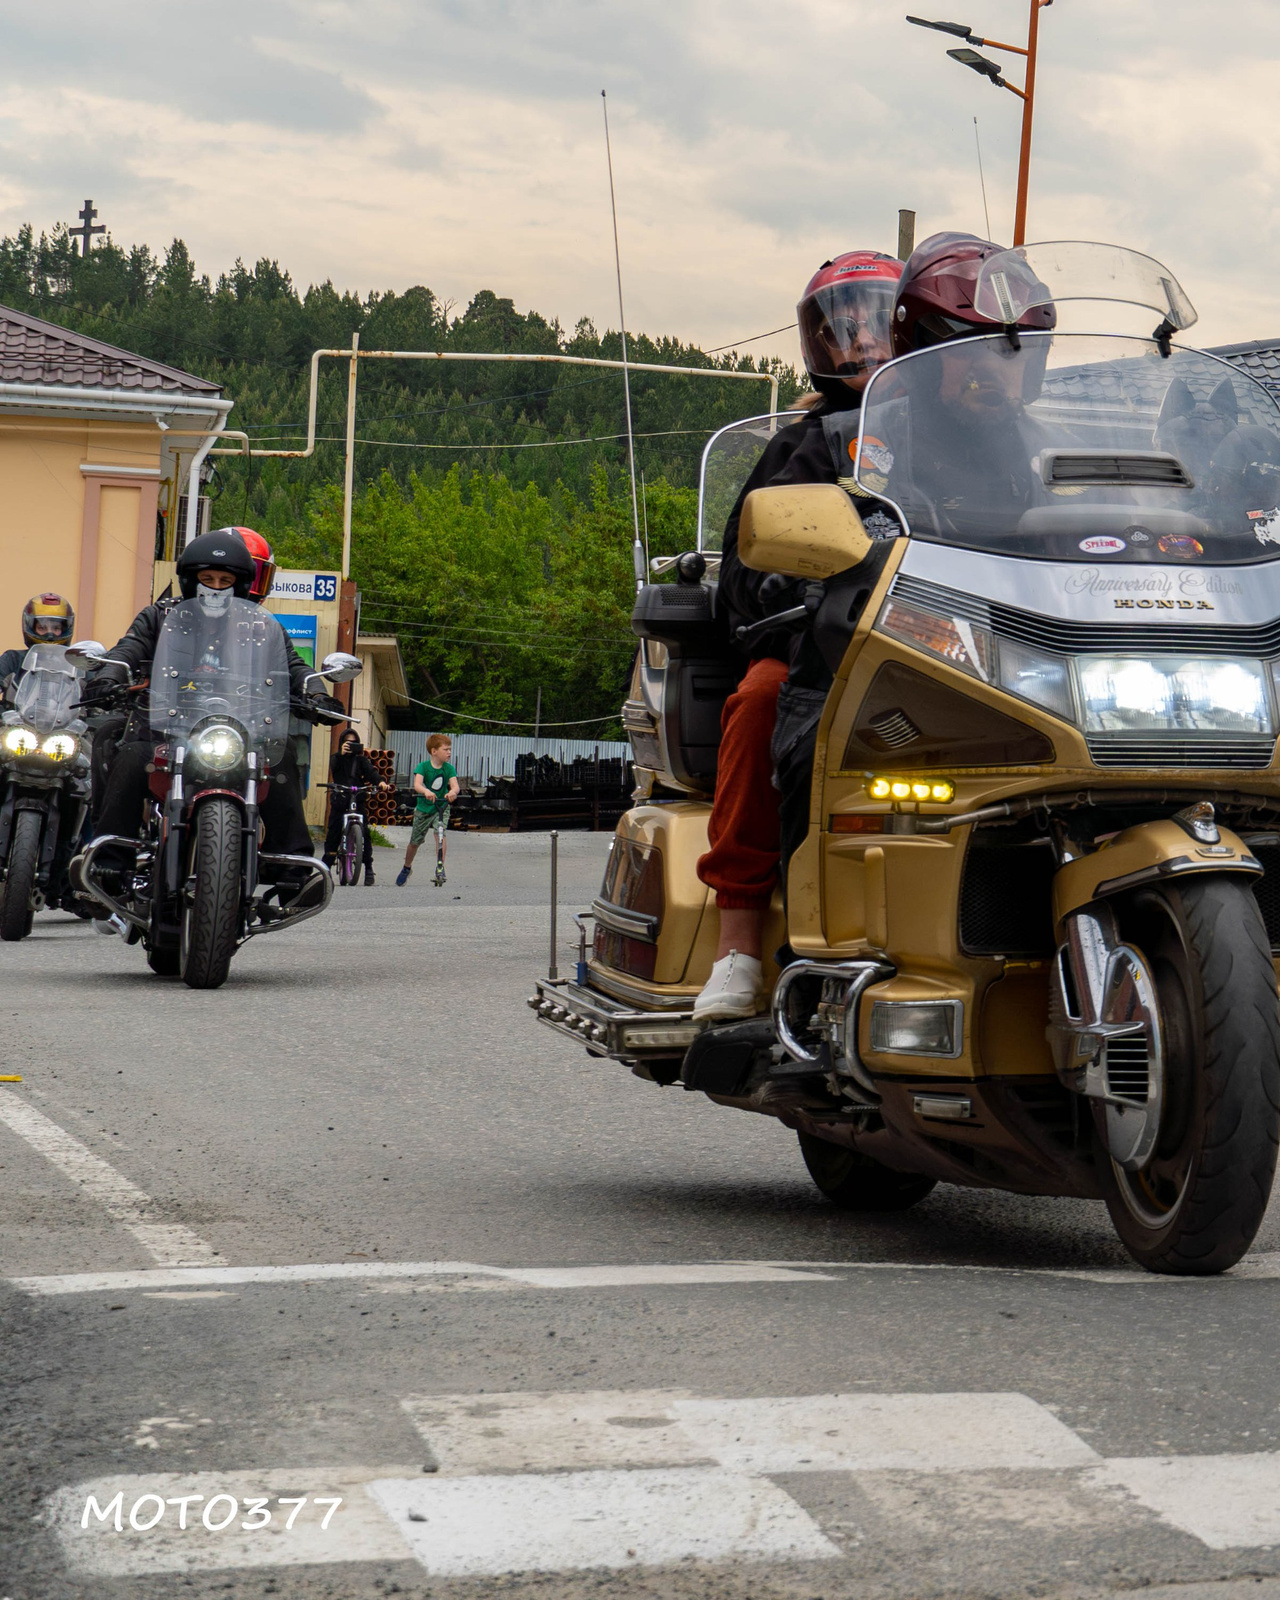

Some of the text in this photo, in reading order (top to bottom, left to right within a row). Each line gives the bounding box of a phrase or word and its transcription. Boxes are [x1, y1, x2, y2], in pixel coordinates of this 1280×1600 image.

[316, 579, 335, 597] 35
[1064, 568, 1245, 597] Anniversary Edition
[1114, 599, 1215, 610] HONDA
